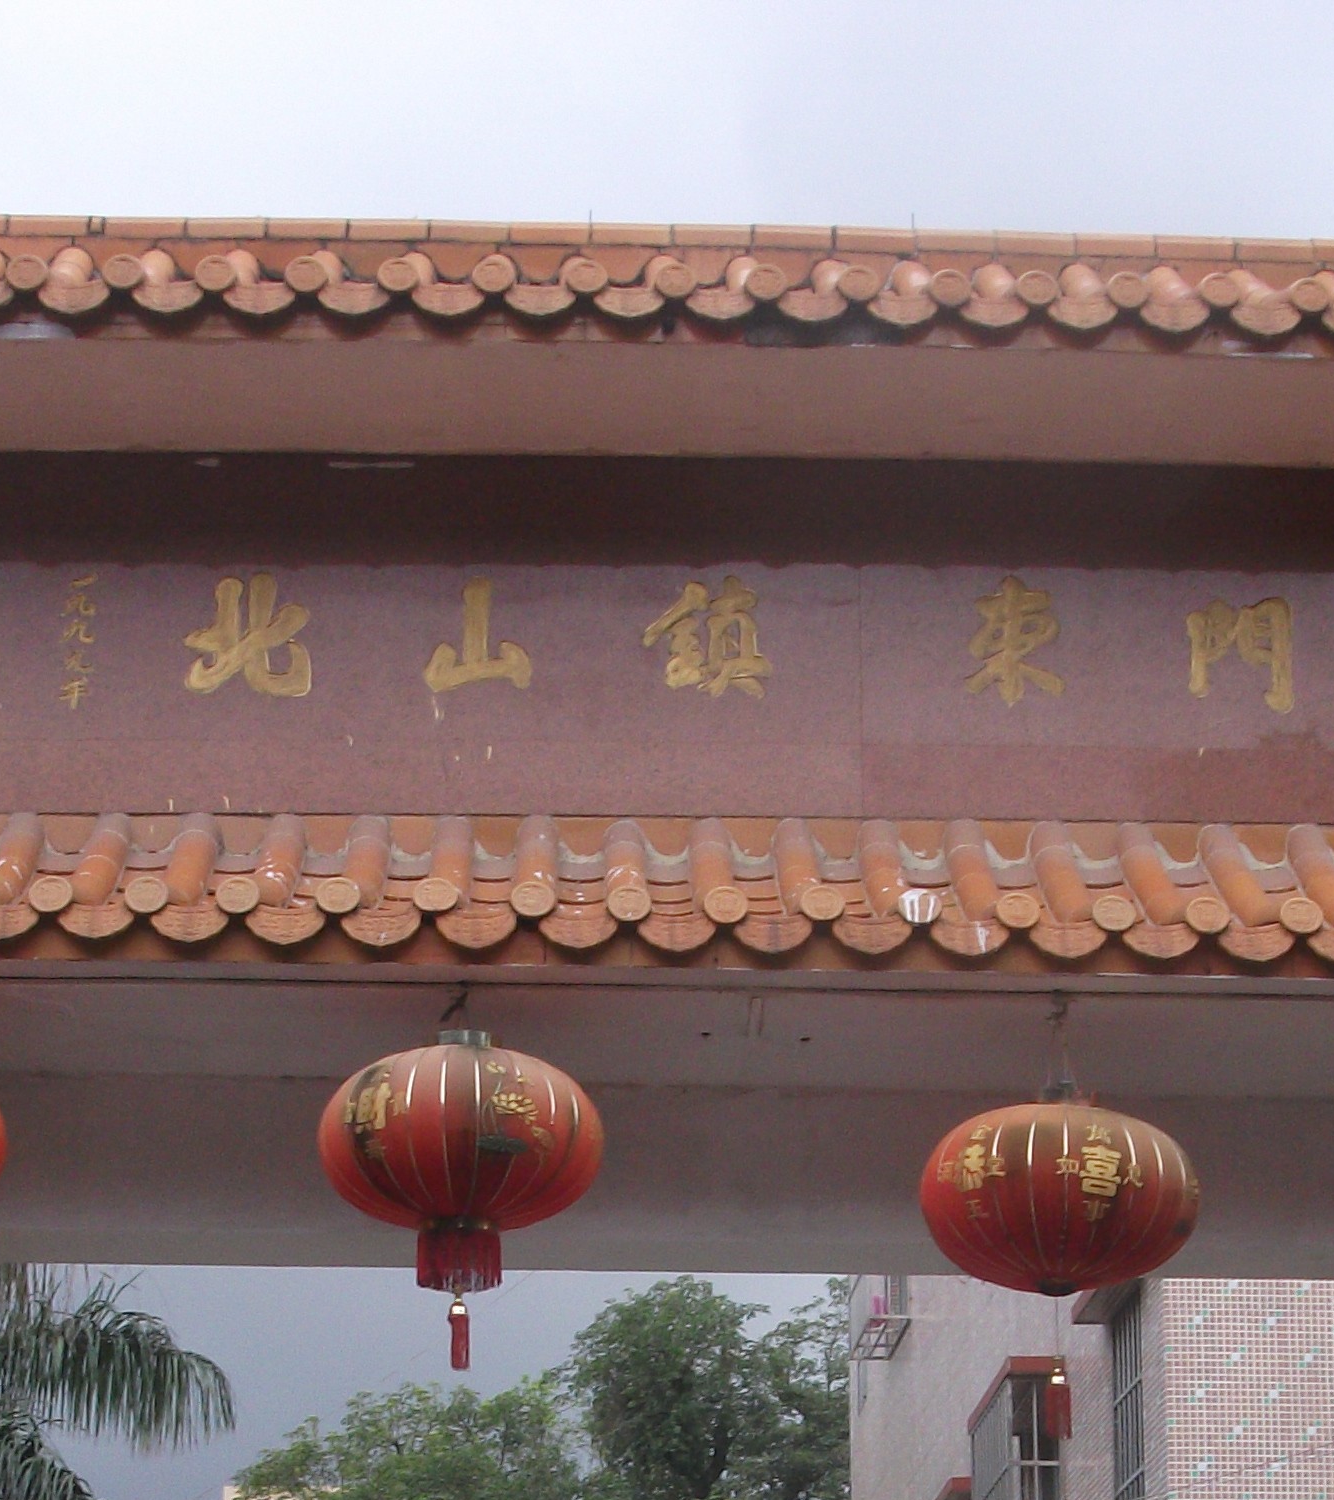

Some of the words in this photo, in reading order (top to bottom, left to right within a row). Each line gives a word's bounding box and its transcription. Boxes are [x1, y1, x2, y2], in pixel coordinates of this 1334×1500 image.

[184, 573, 1294, 714] 北山鎮東門
